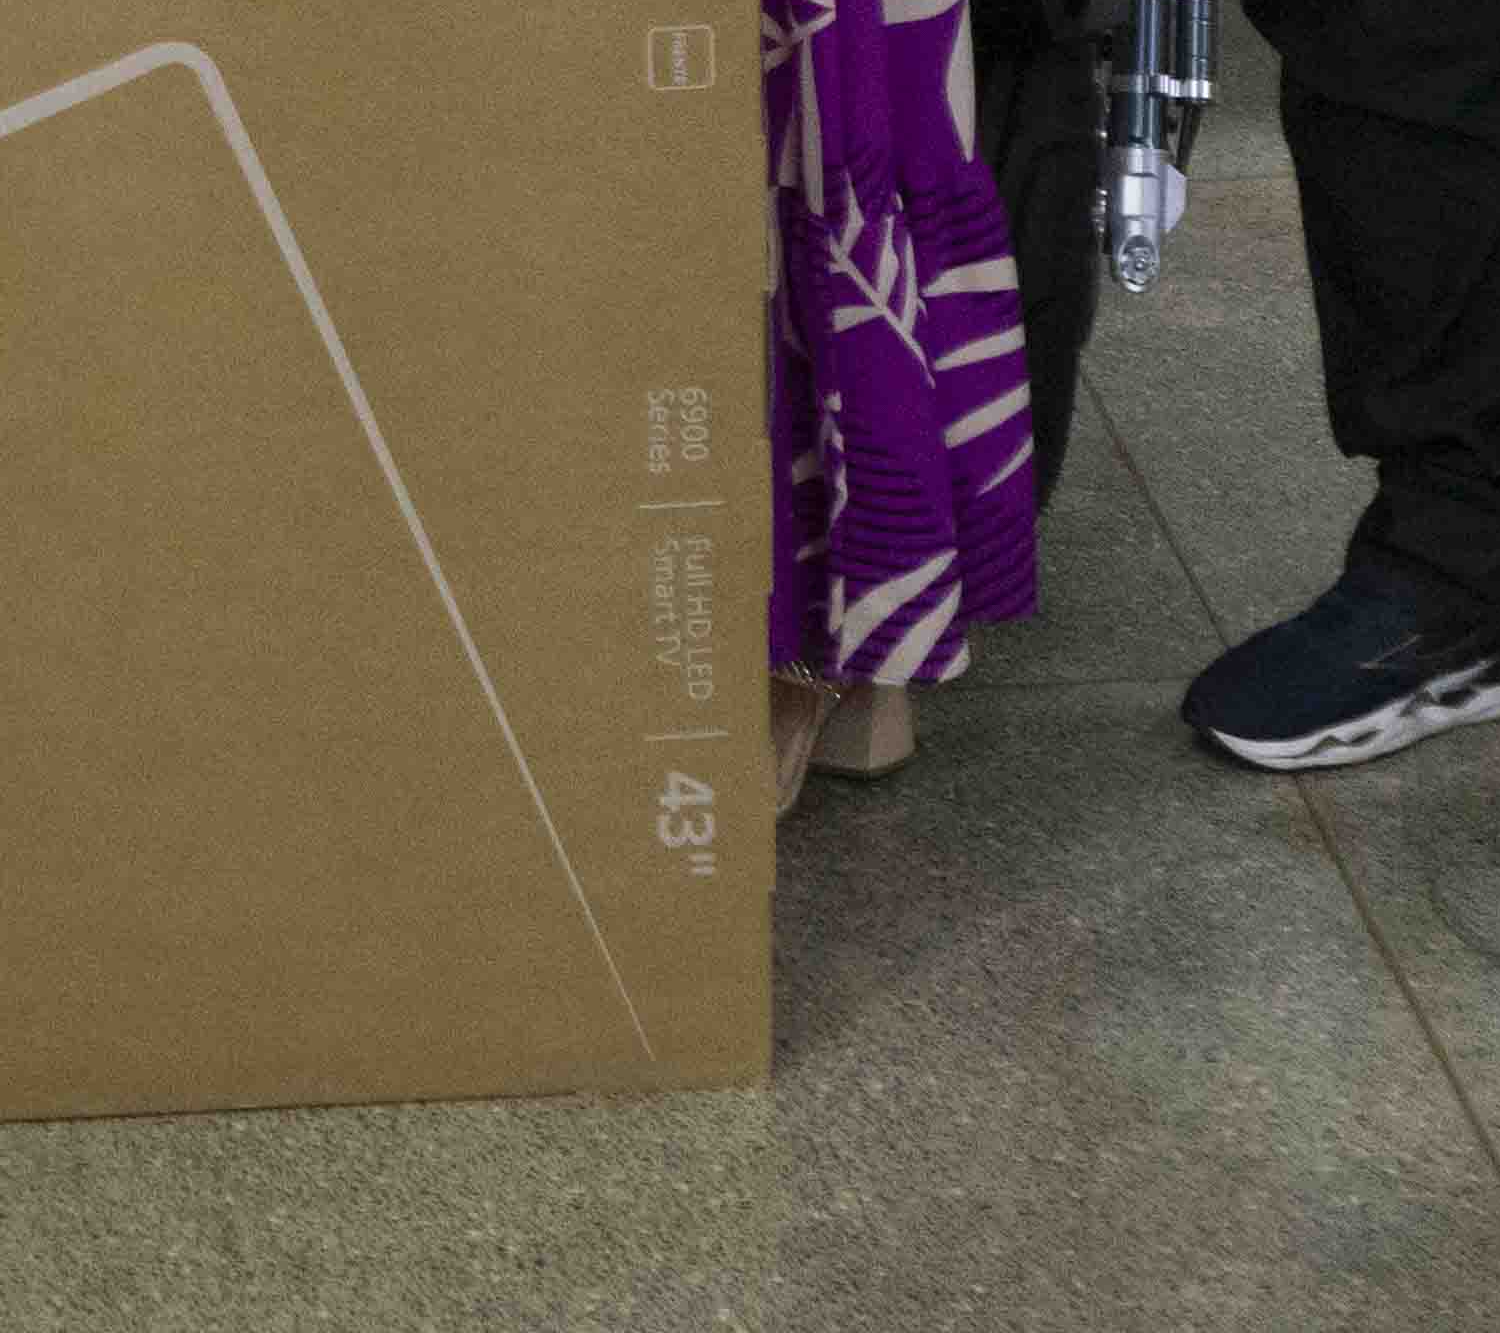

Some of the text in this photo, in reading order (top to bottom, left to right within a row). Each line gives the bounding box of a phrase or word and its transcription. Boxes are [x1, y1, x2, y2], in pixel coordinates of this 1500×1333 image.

[648, 388, 675, 474] Series
[679, 388, 709, 463] 6900
[654, 538, 682, 668] Smart TV
[685, 535, 714, 701] Full HD LED
